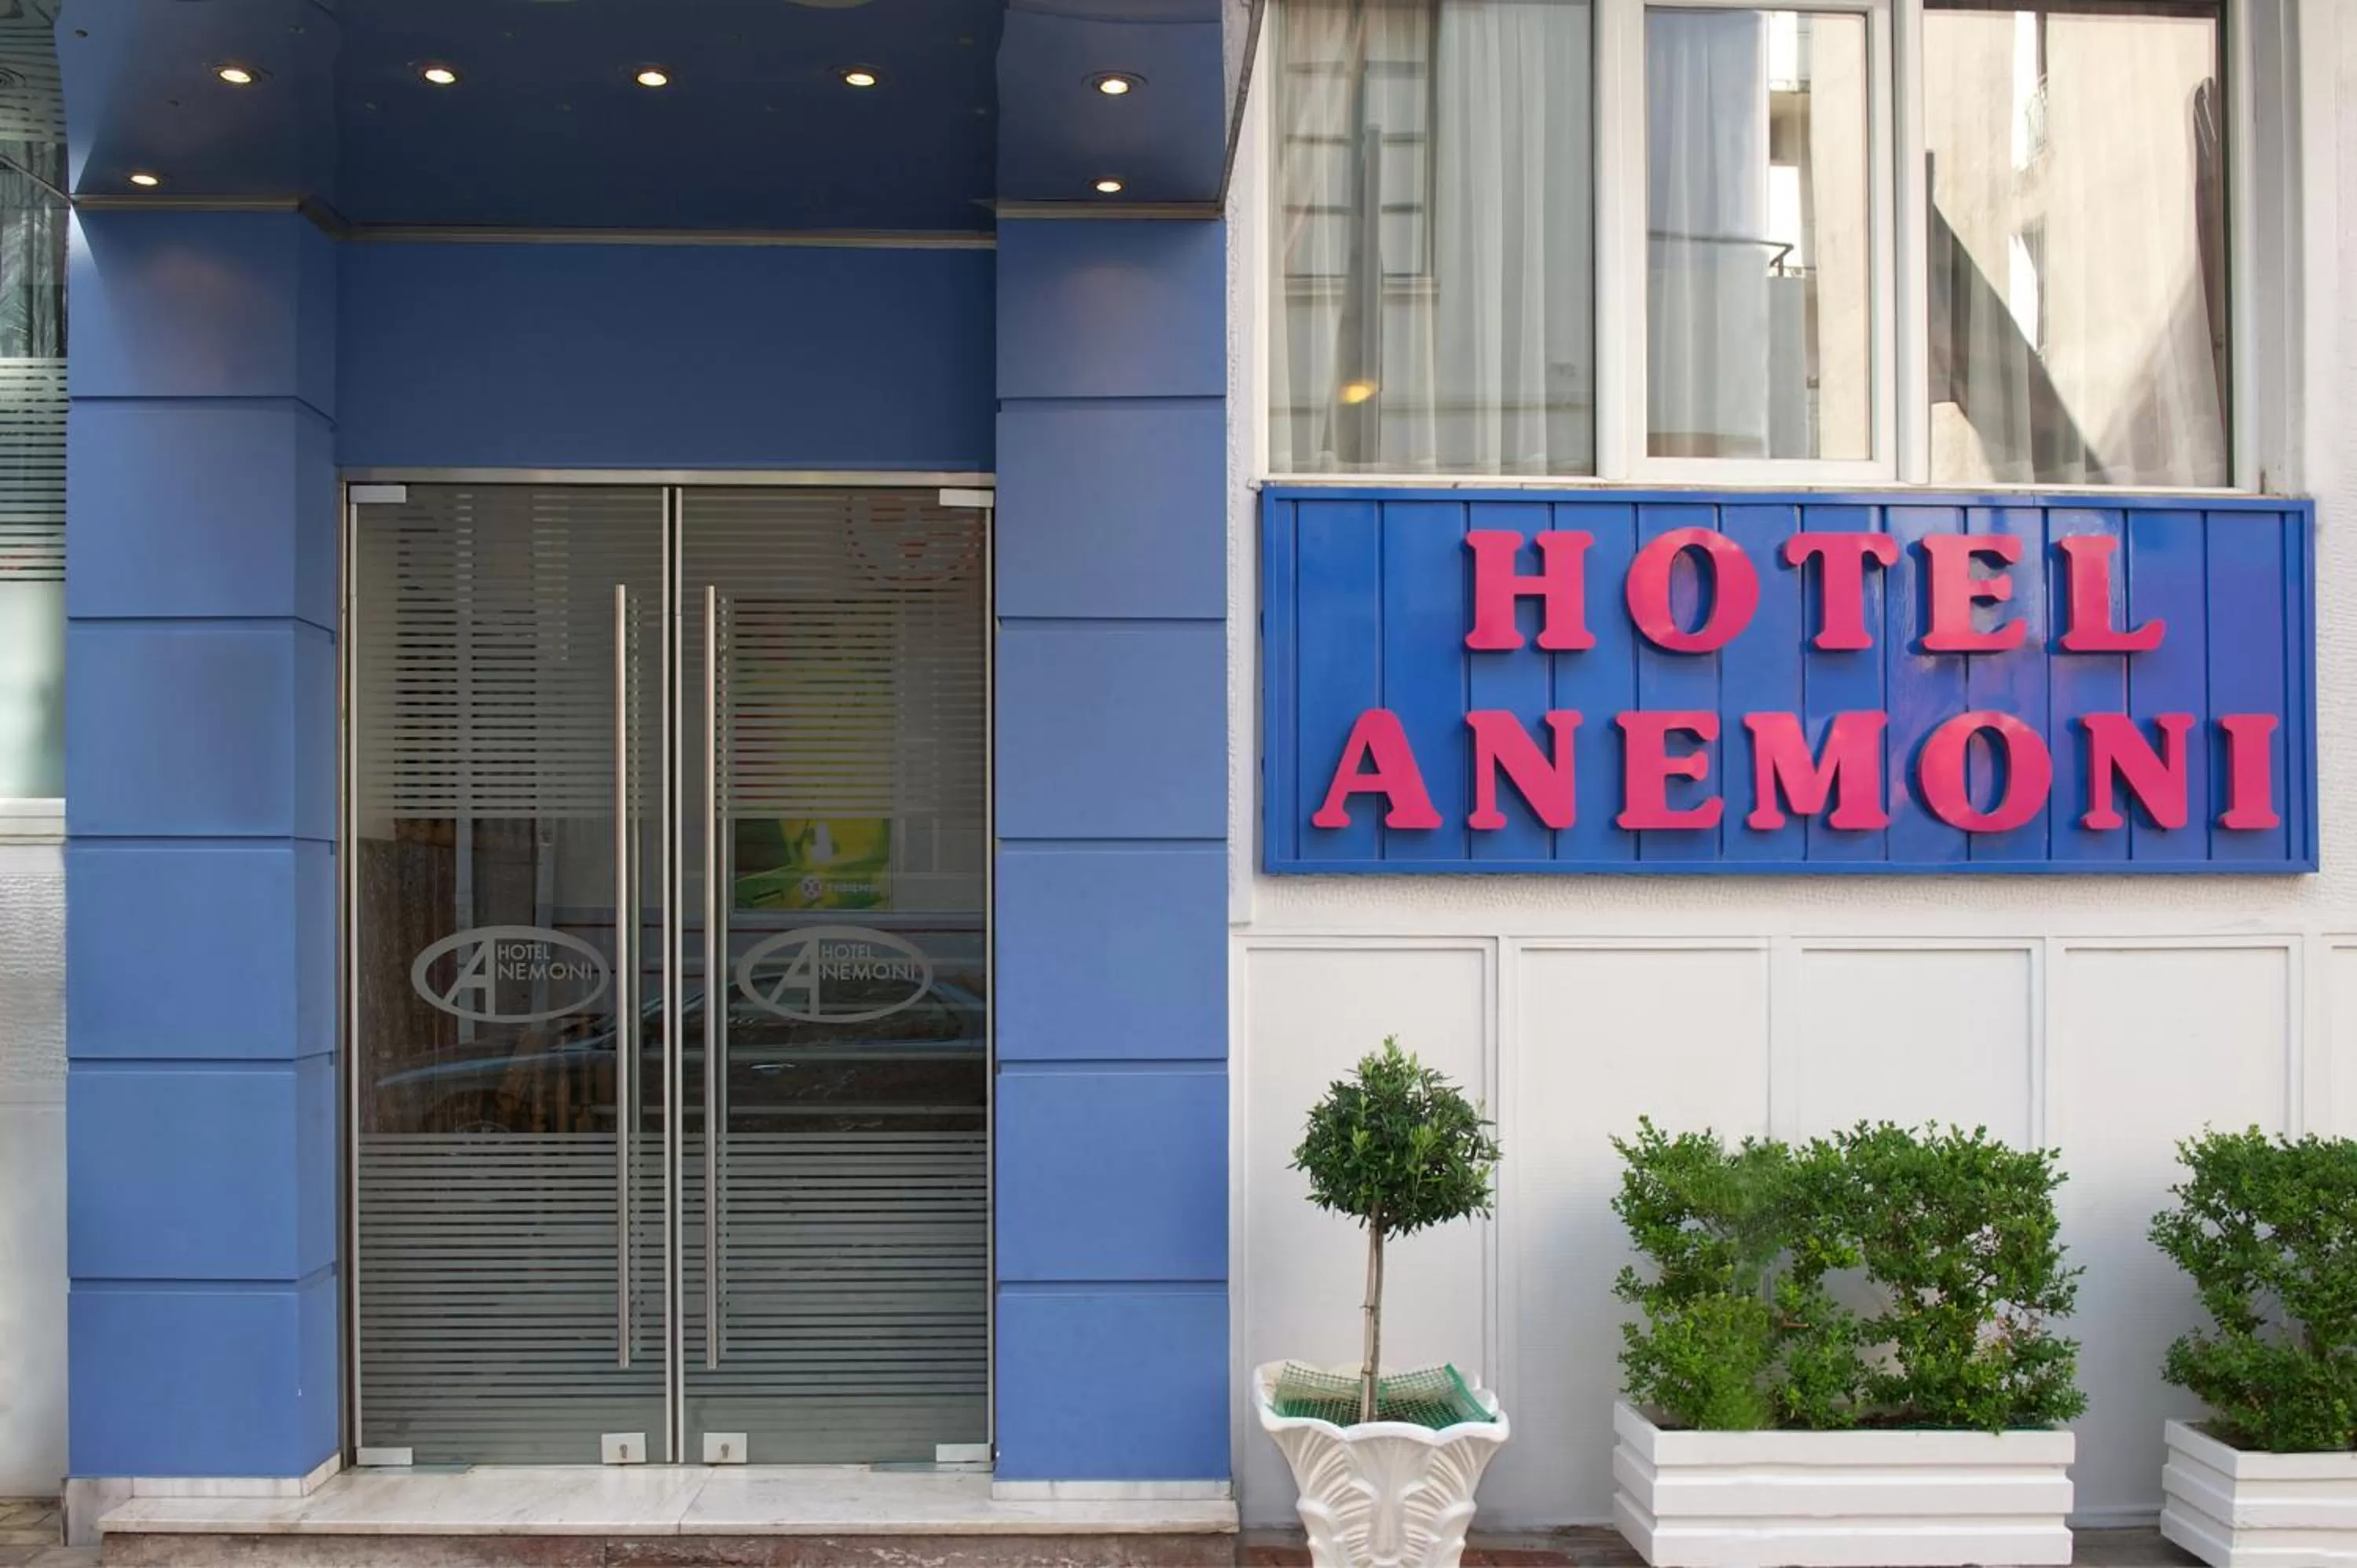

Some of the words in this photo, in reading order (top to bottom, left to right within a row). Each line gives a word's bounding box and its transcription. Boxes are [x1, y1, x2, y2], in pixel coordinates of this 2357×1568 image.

[1465, 527, 2164, 651] HOTEL
[1313, 709, 2279, 833] ANEMONI
[497, 944, 552, 960] HOTEL
[822, 944, 874, 959] HOTEL
